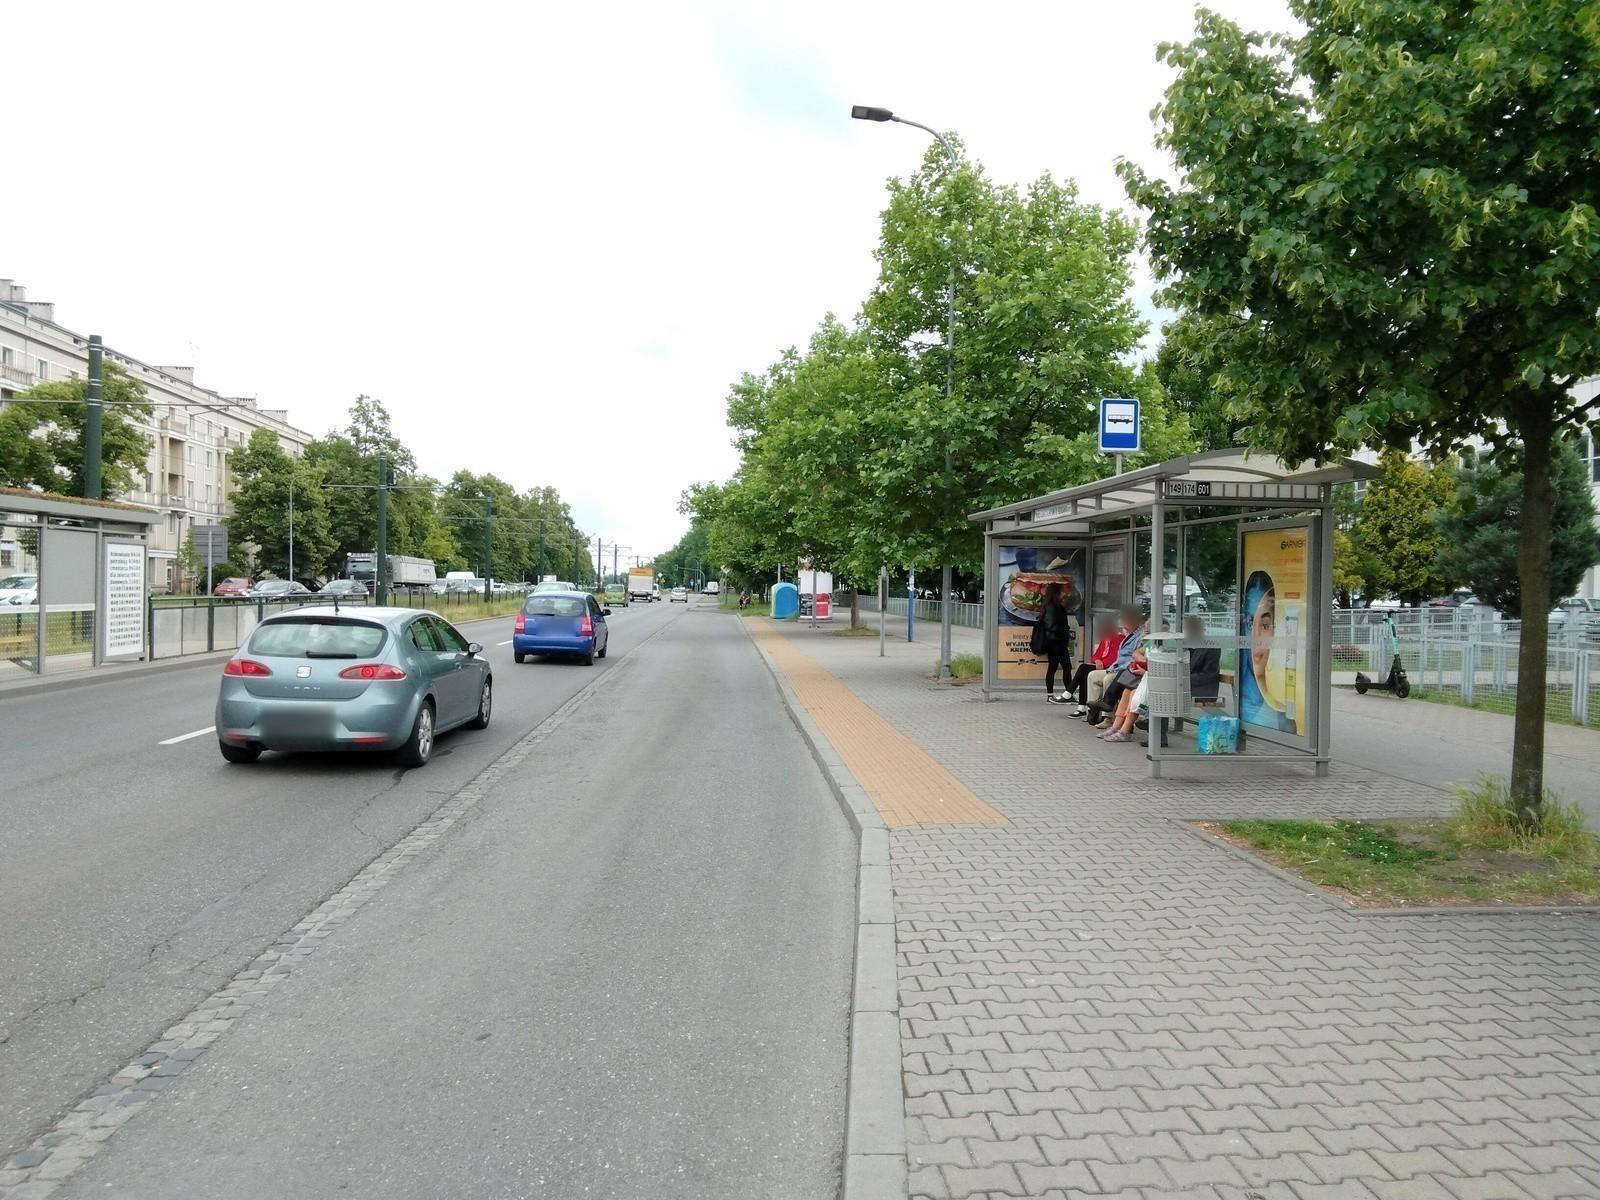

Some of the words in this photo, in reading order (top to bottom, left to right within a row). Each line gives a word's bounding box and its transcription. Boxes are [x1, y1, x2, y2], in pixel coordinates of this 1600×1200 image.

[1170, 483, 1182, 494] 149
[1184, 483, 1195, 494] 174
[1198, 483, 1209, 495] 601
